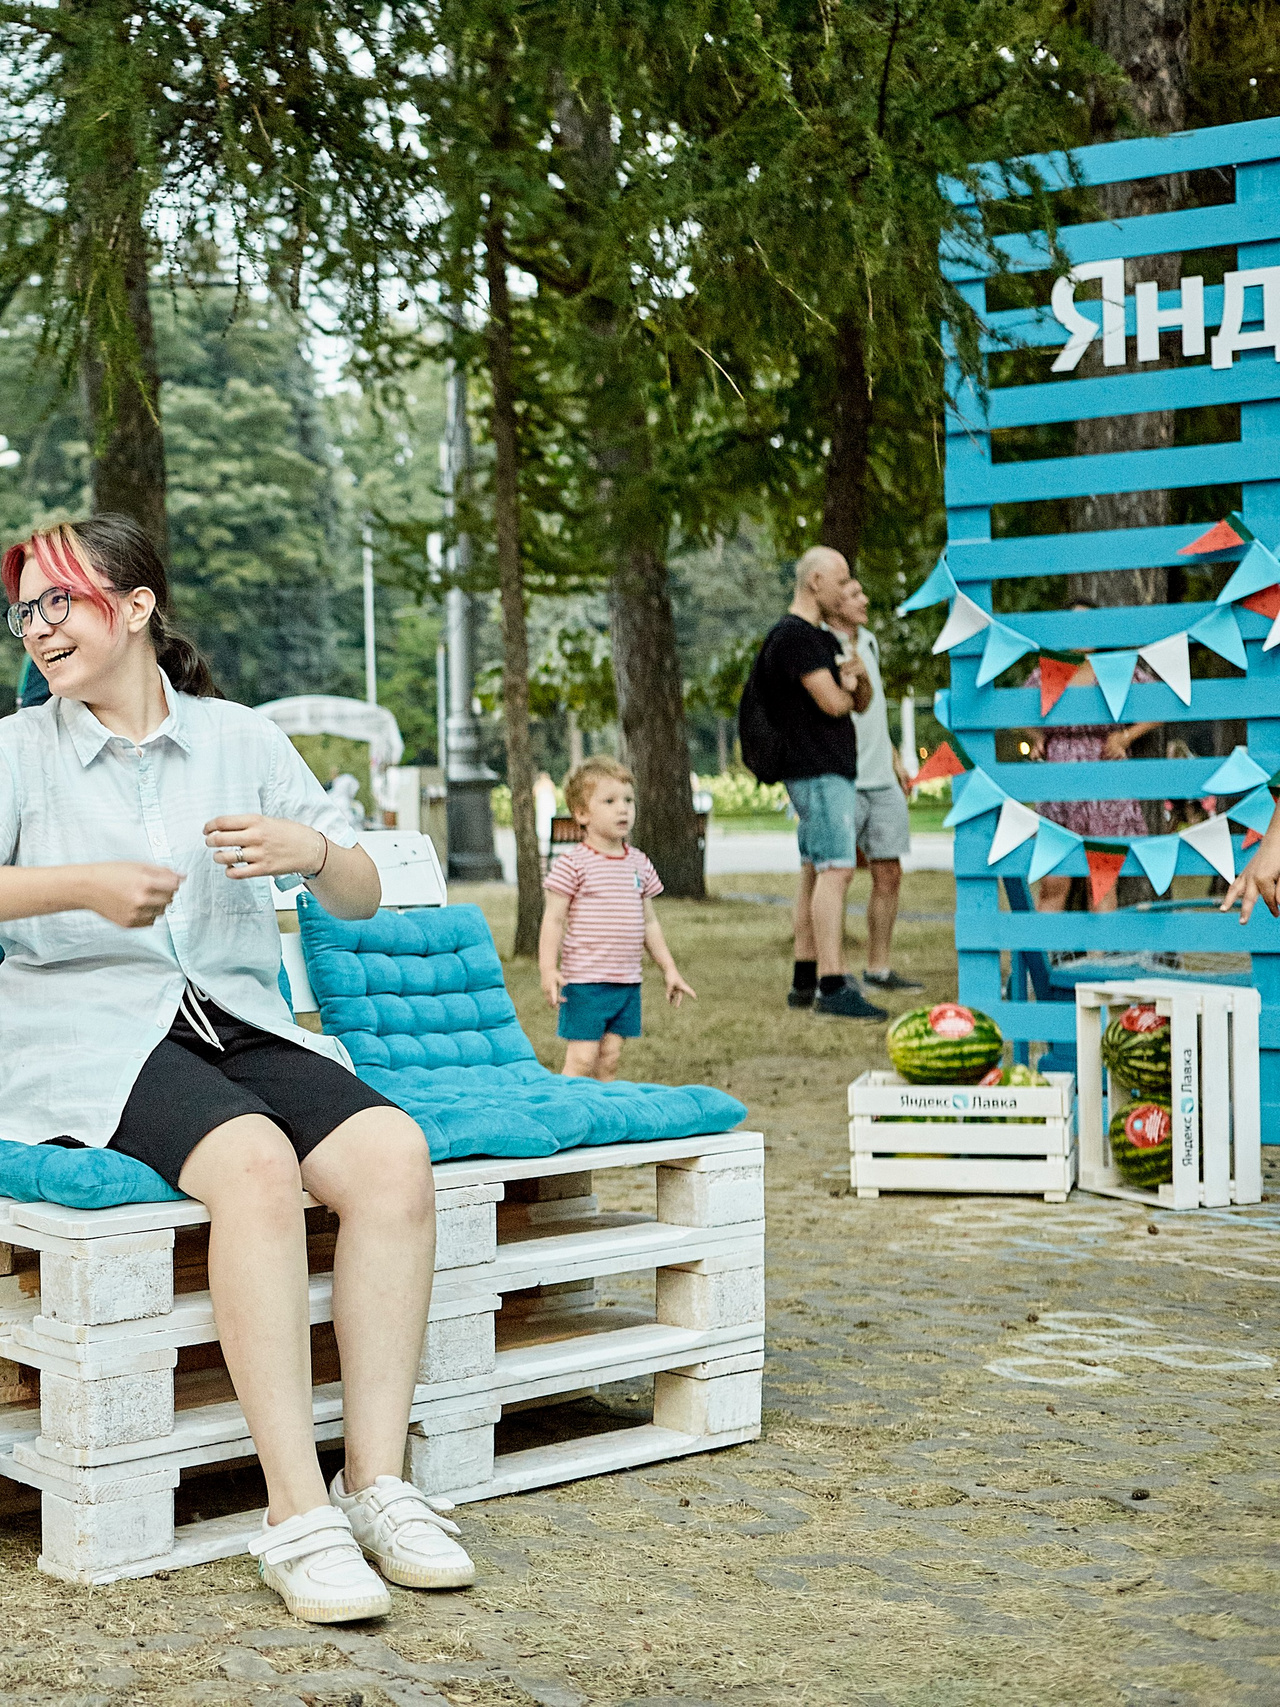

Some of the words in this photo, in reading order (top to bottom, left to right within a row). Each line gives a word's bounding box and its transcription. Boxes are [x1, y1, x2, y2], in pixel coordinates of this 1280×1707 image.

[1181, 1048, 1193, 1093] Лавка
[900, 1094, 951, 1109] Яндекс
[972, 1096, 1018, 1109] Лавка
[1182, 1116, 1193, 1167] Яндекс
